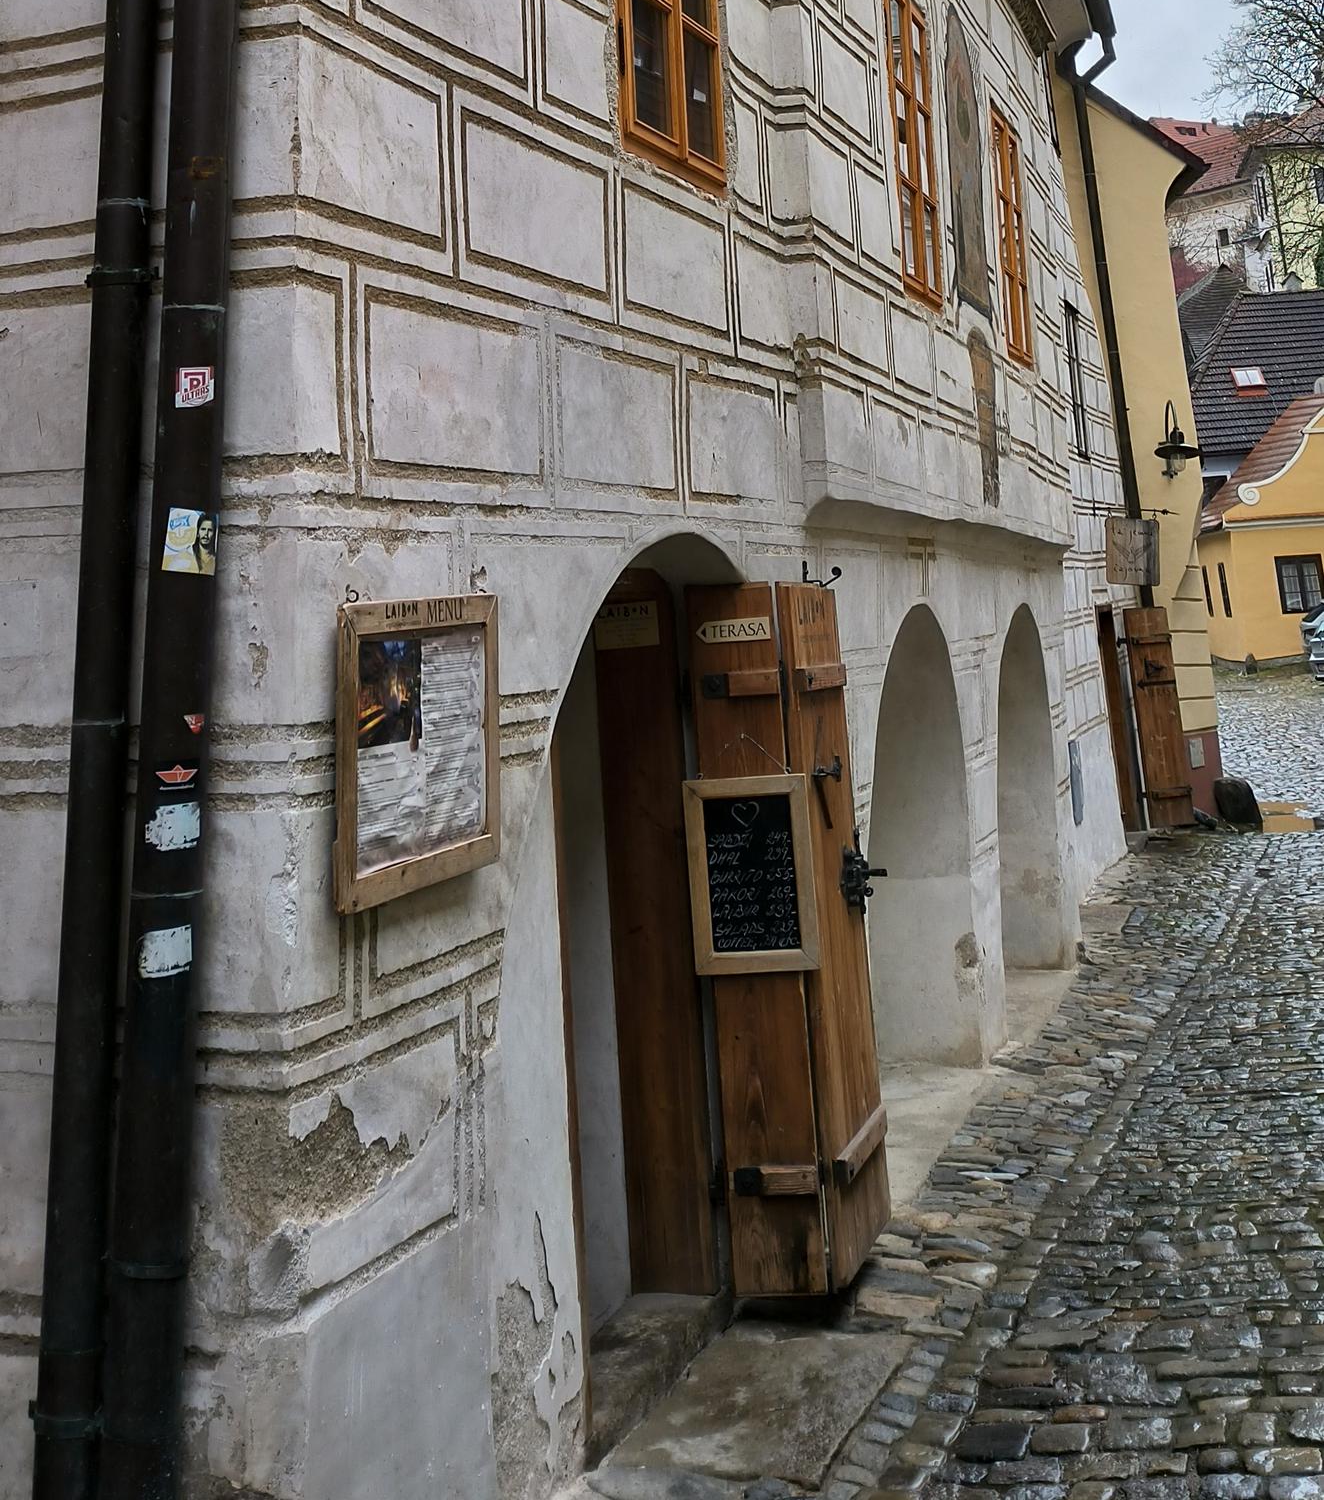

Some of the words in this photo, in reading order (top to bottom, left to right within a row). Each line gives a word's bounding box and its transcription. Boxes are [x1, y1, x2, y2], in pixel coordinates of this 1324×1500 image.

[181, 384, 210, 403] ULTRAS
[385, 602, 418, 619] LAIBON
[426, 597, 463, 625] MENU
[711, 622, 767, 638] TERASA
[709, 851, 741, 865] DHAL
